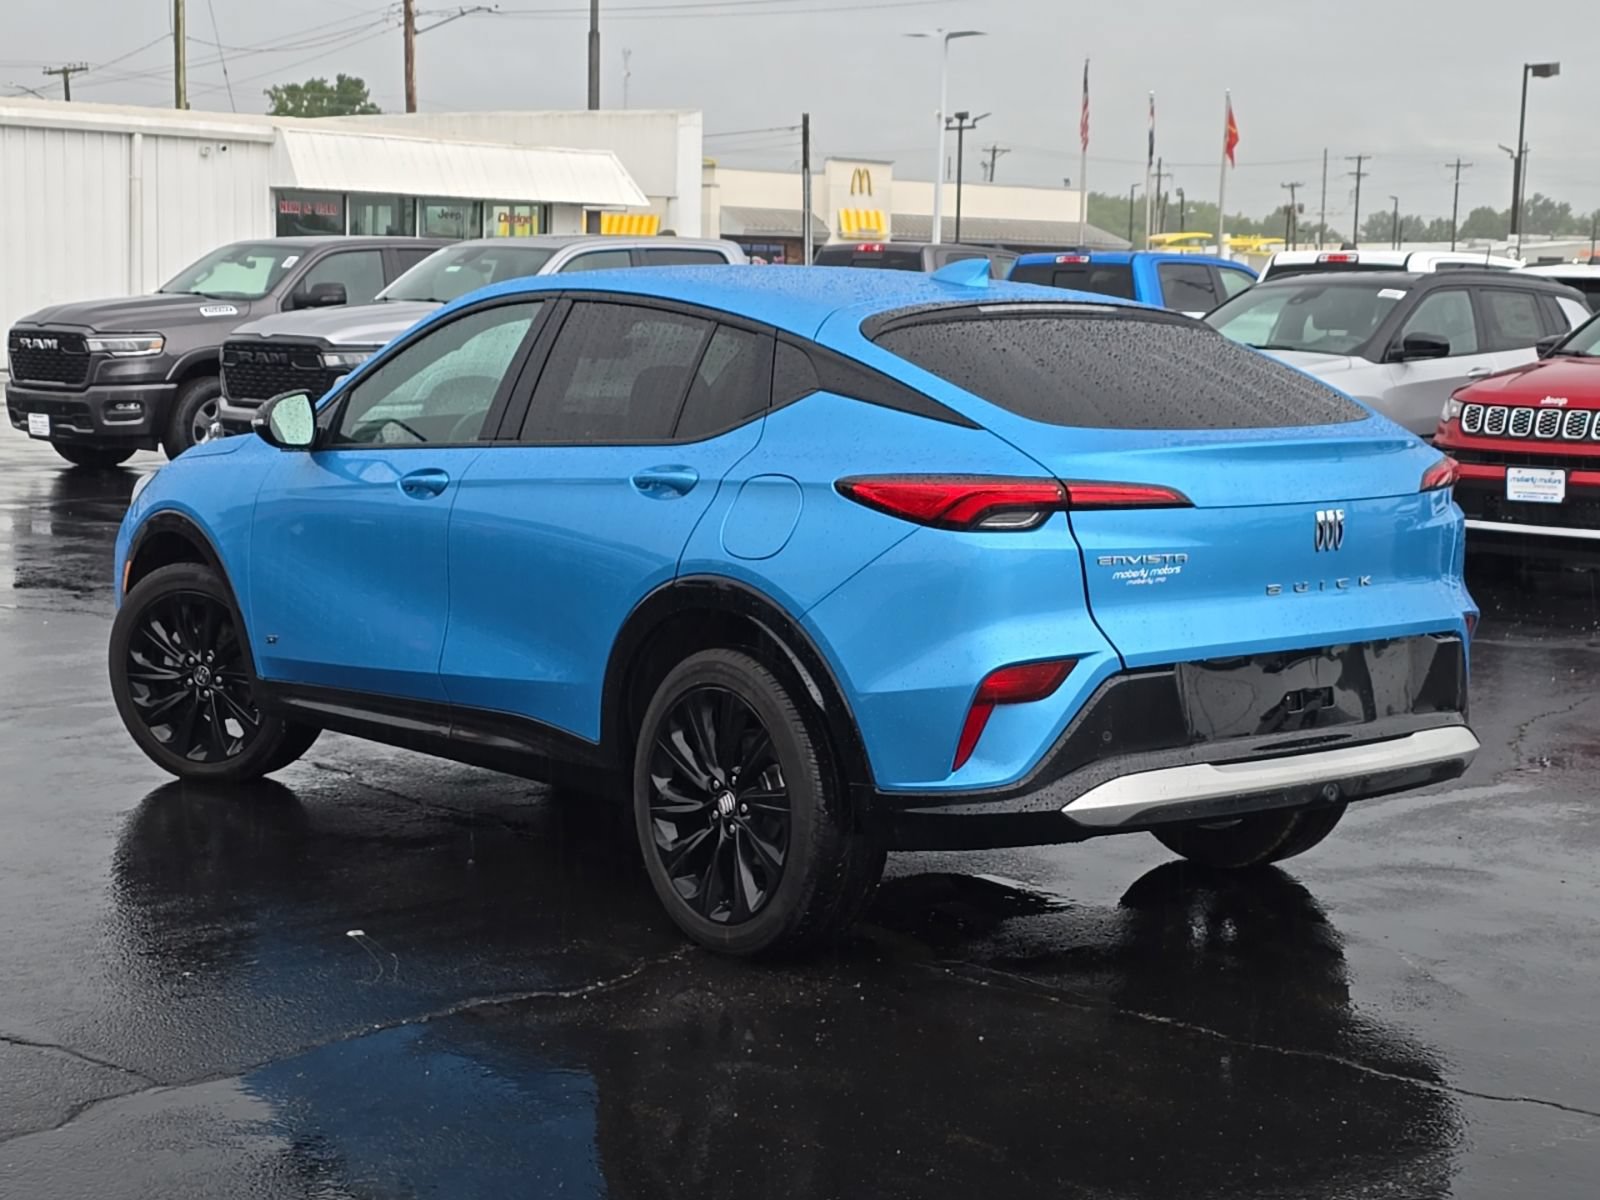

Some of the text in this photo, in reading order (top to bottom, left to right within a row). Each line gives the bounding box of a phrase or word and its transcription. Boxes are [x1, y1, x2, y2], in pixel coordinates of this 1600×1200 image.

[437, 208, 462, 220] Jeep
[498, 212, 533, 227] Dodge
[20, 338, 58, 350] RAM
[239, 351, 288, 363] RAM
[1540, 396, 1568, 406] Jeep
[1097, 553, 1188, 566] ENVISTA
[1112, 564, 1182, 580] moberly motors
[1266, 575, 1371, 596] BUICK
